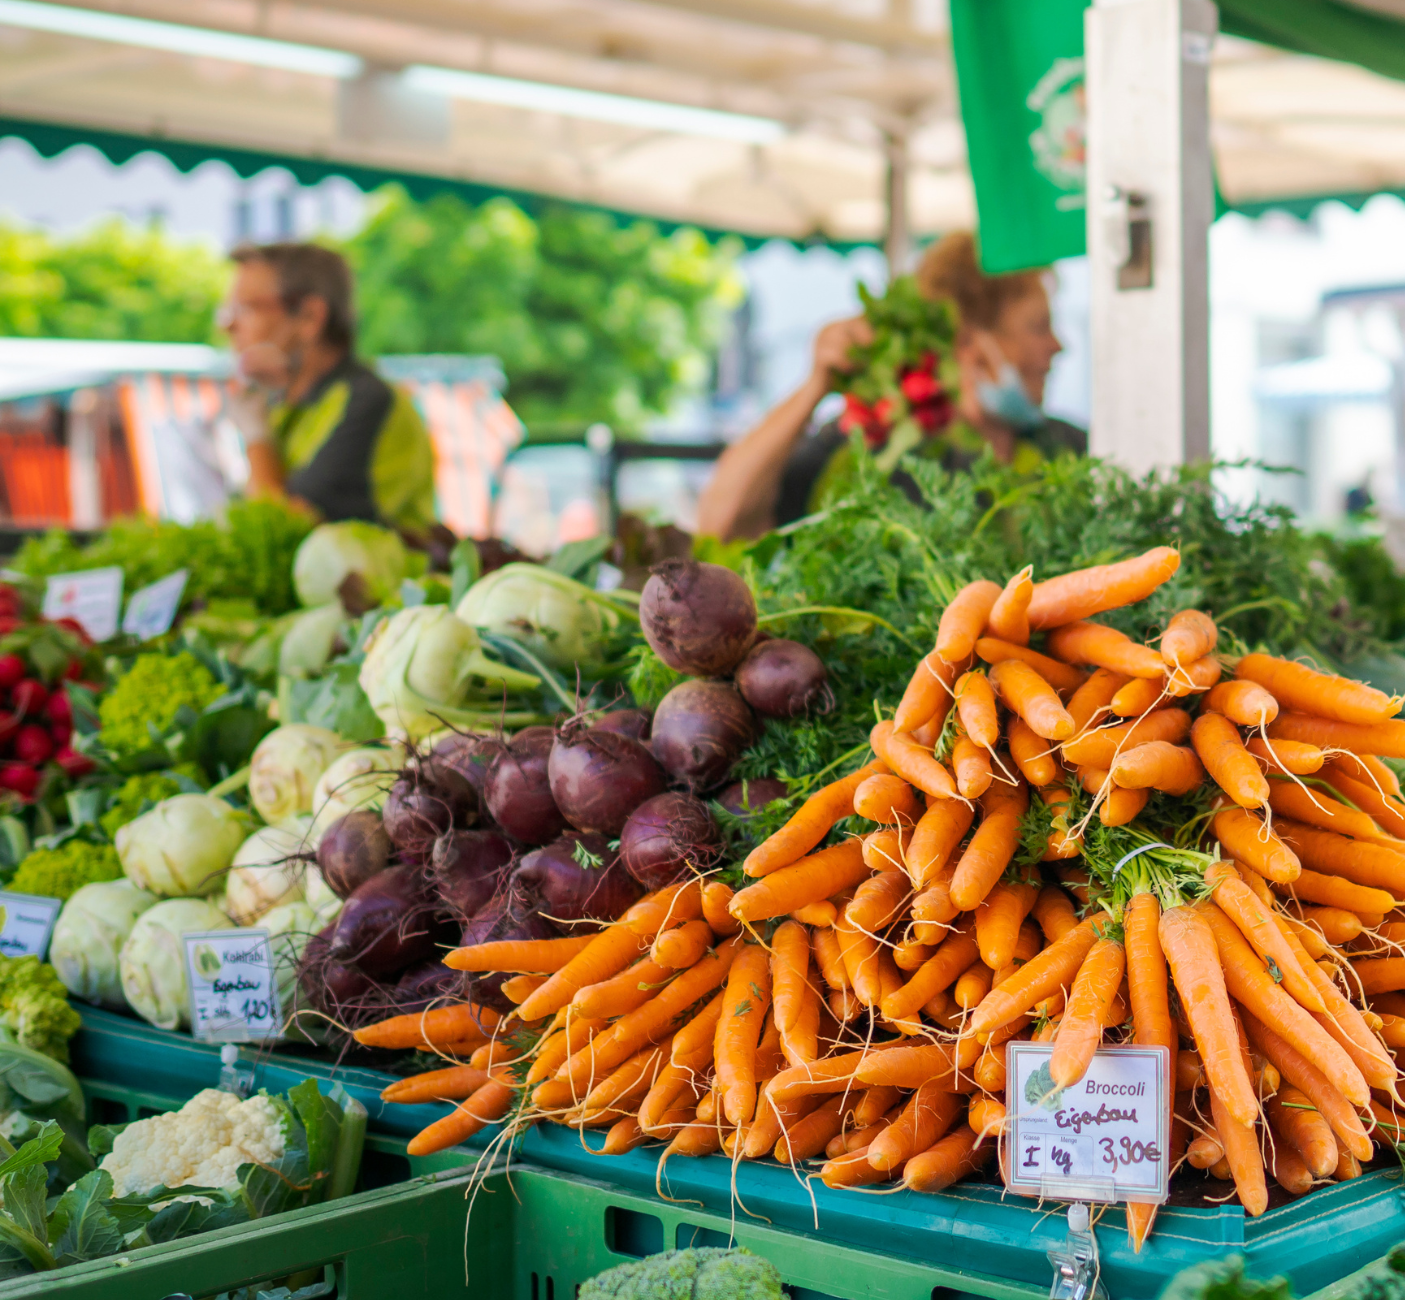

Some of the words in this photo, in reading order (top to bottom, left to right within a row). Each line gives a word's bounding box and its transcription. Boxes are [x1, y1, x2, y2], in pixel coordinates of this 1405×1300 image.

[222, 949, 264, 963] Kohlrabi
[1085, 1080, 1145, 1096] Broccoli
[1054, 1103, 1139, 1134] Eigenbau
[1060, 1136, 1078, 1145] Menge
[1023, 1145, 1041, 1167] I
[1051, 1145, 1073, 1176] kg
[1099, 1136, 1161, 1173] 3,90€
